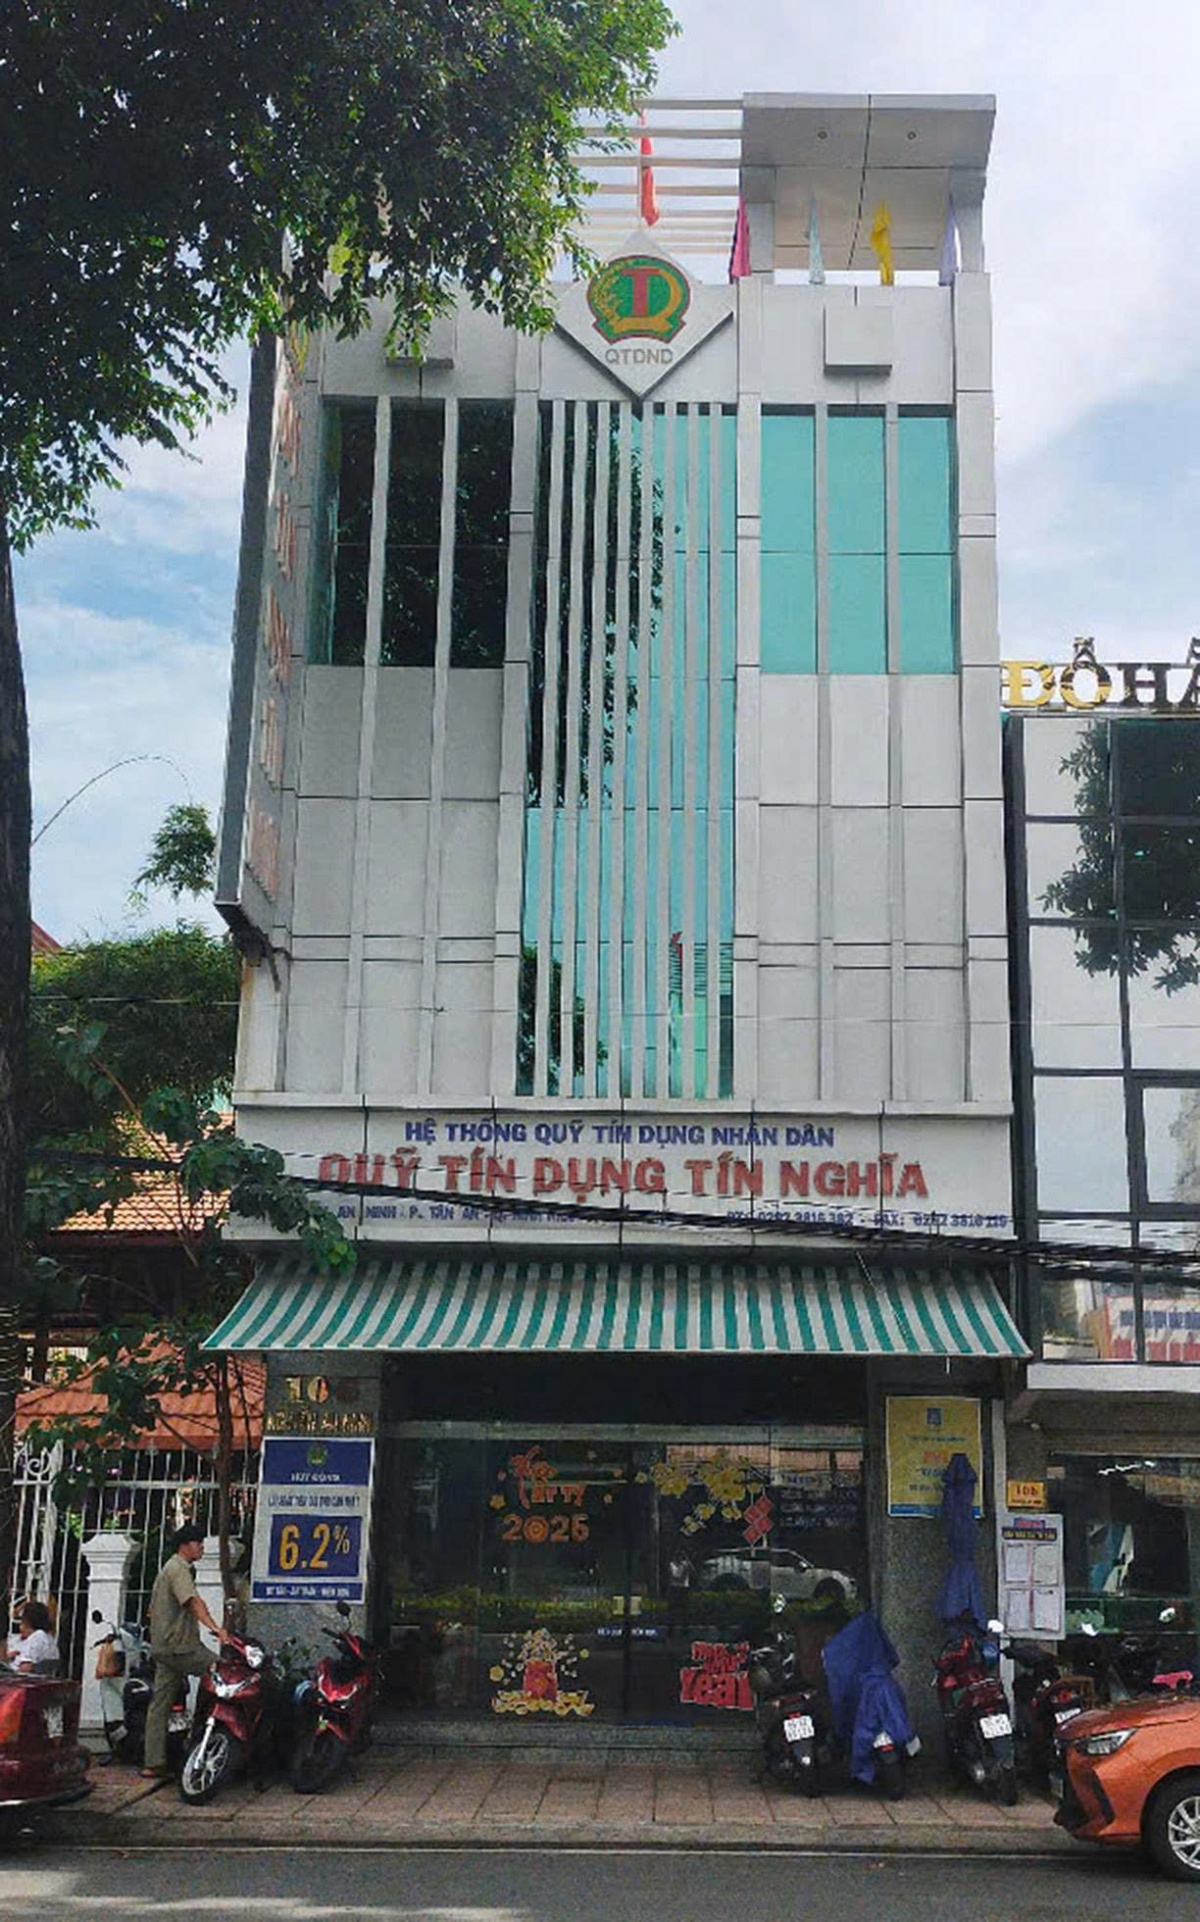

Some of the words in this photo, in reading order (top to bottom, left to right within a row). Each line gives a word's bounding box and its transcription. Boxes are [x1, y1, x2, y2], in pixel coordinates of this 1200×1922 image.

[604, 348, 674, 365] QTDND
[405, 1117, 437, 1146] HỆ
[534, 1119, 584, 1145] QUỸ
[592, 1119, 631, 1144] TÍN
[711, 1121, 778, 1146] NHÂN
[785, 1122, 834, 1148] DÂN
[439, 1145, 516, 1193] TÍN
[533, 1157, 666, 1203] DỤNG
[684, 1151, 764, 1197] TÍN
[780, 1152, 930, 1199] NGHĨA
[502, 1513, 589, 1543] 2025
